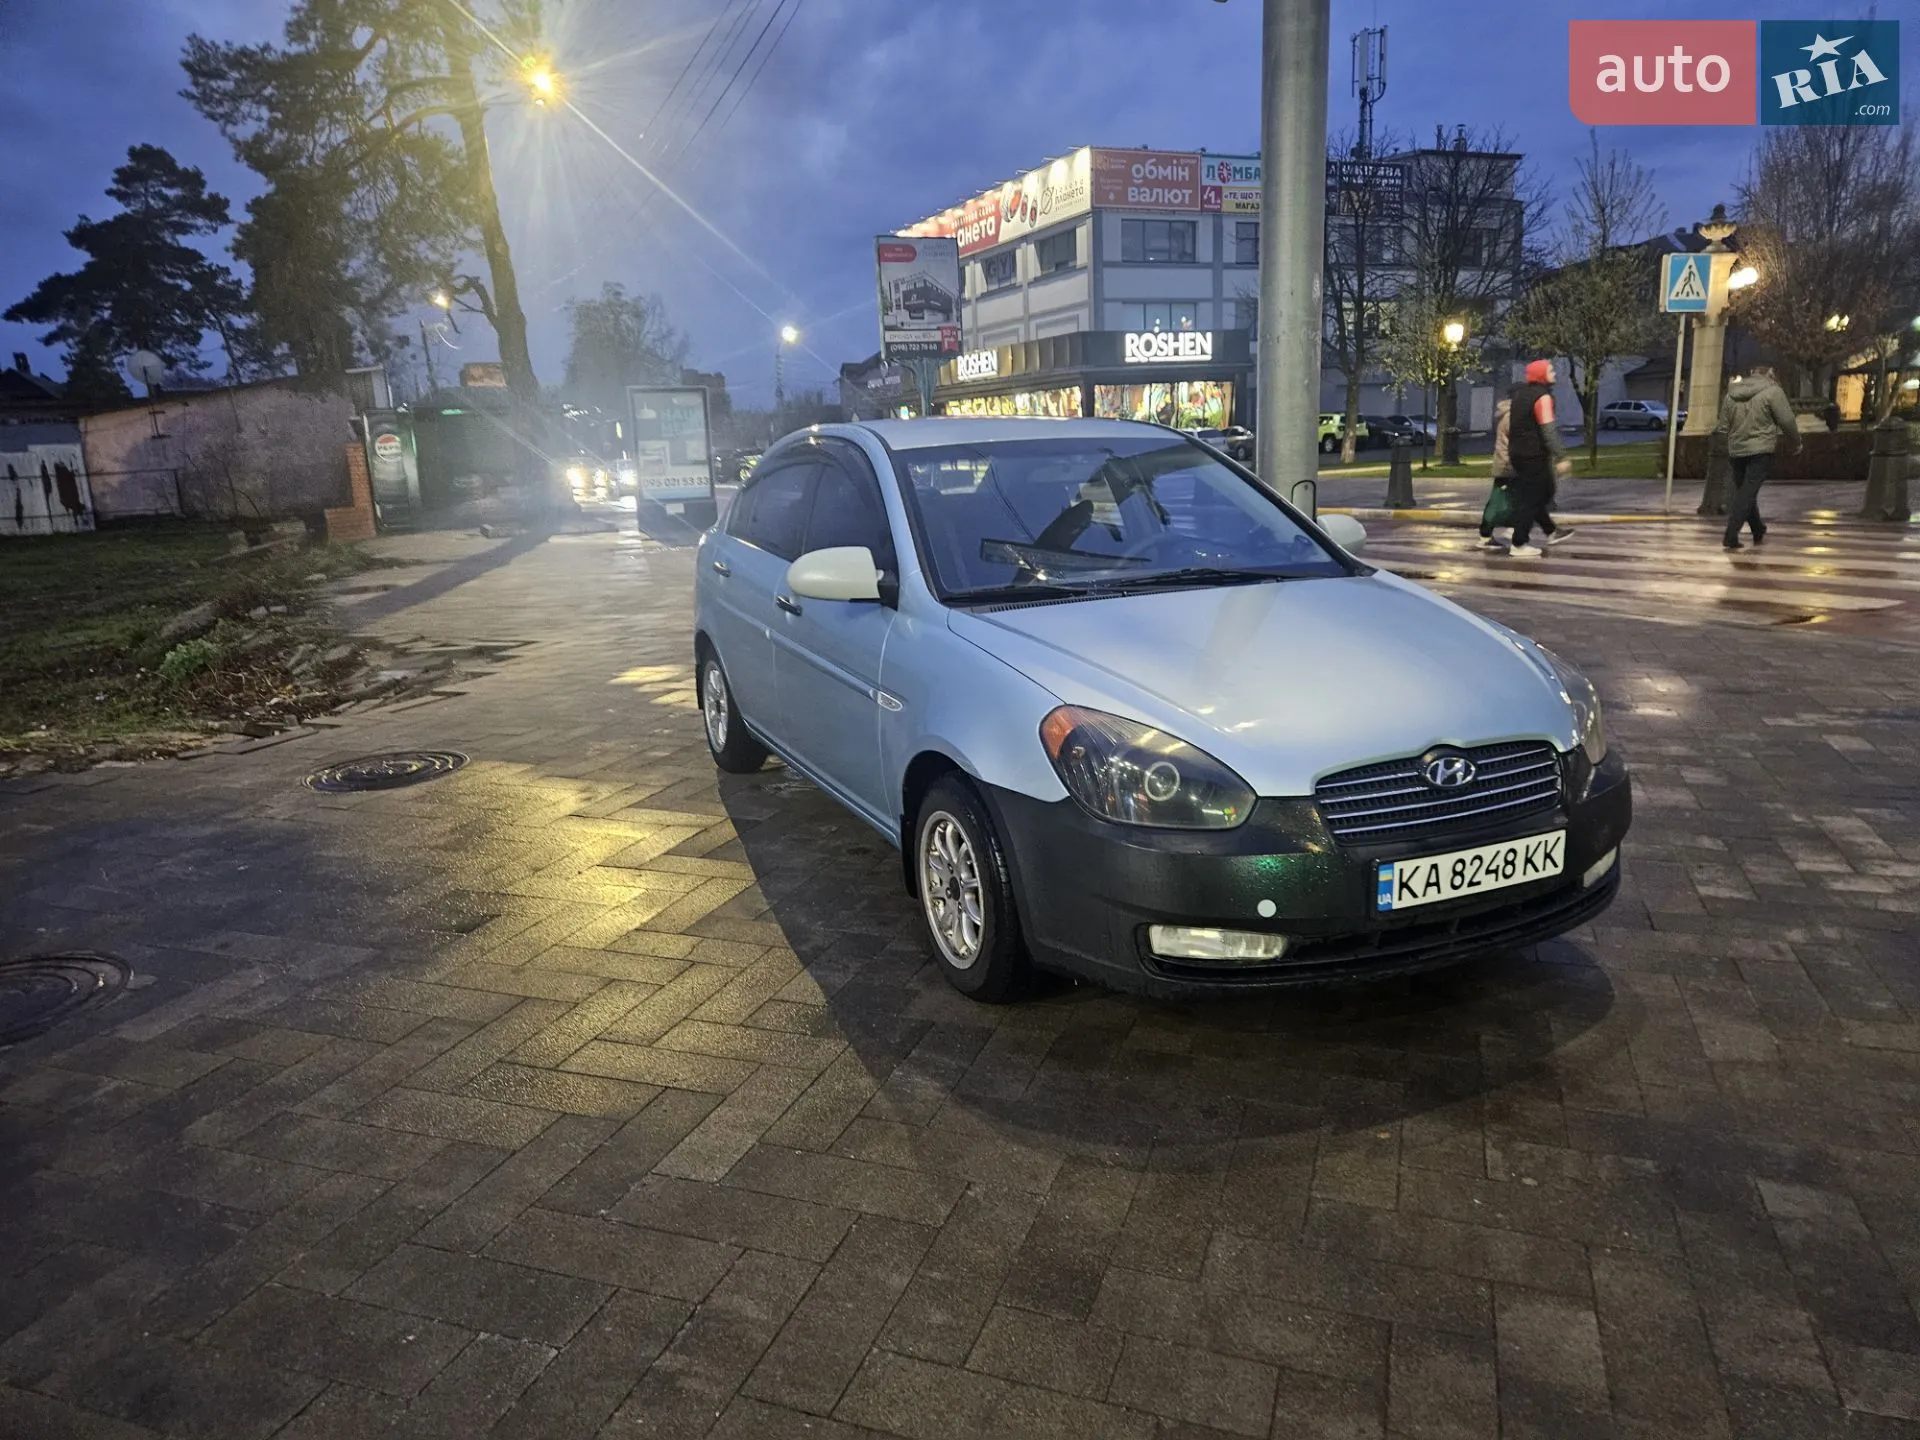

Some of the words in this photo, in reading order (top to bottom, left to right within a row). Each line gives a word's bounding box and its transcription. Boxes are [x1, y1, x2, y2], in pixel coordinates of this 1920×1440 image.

[1131, 158, 1190, 183] обмін
[1127, 186, 1193, 204] валют
[1125, 331, 1213, 362] ROSHEN
[957, 350, 998, 380] ROSHEN
[1450, 848, 1518, 890] 8248
[1377, 894, 1393, 905] UA
